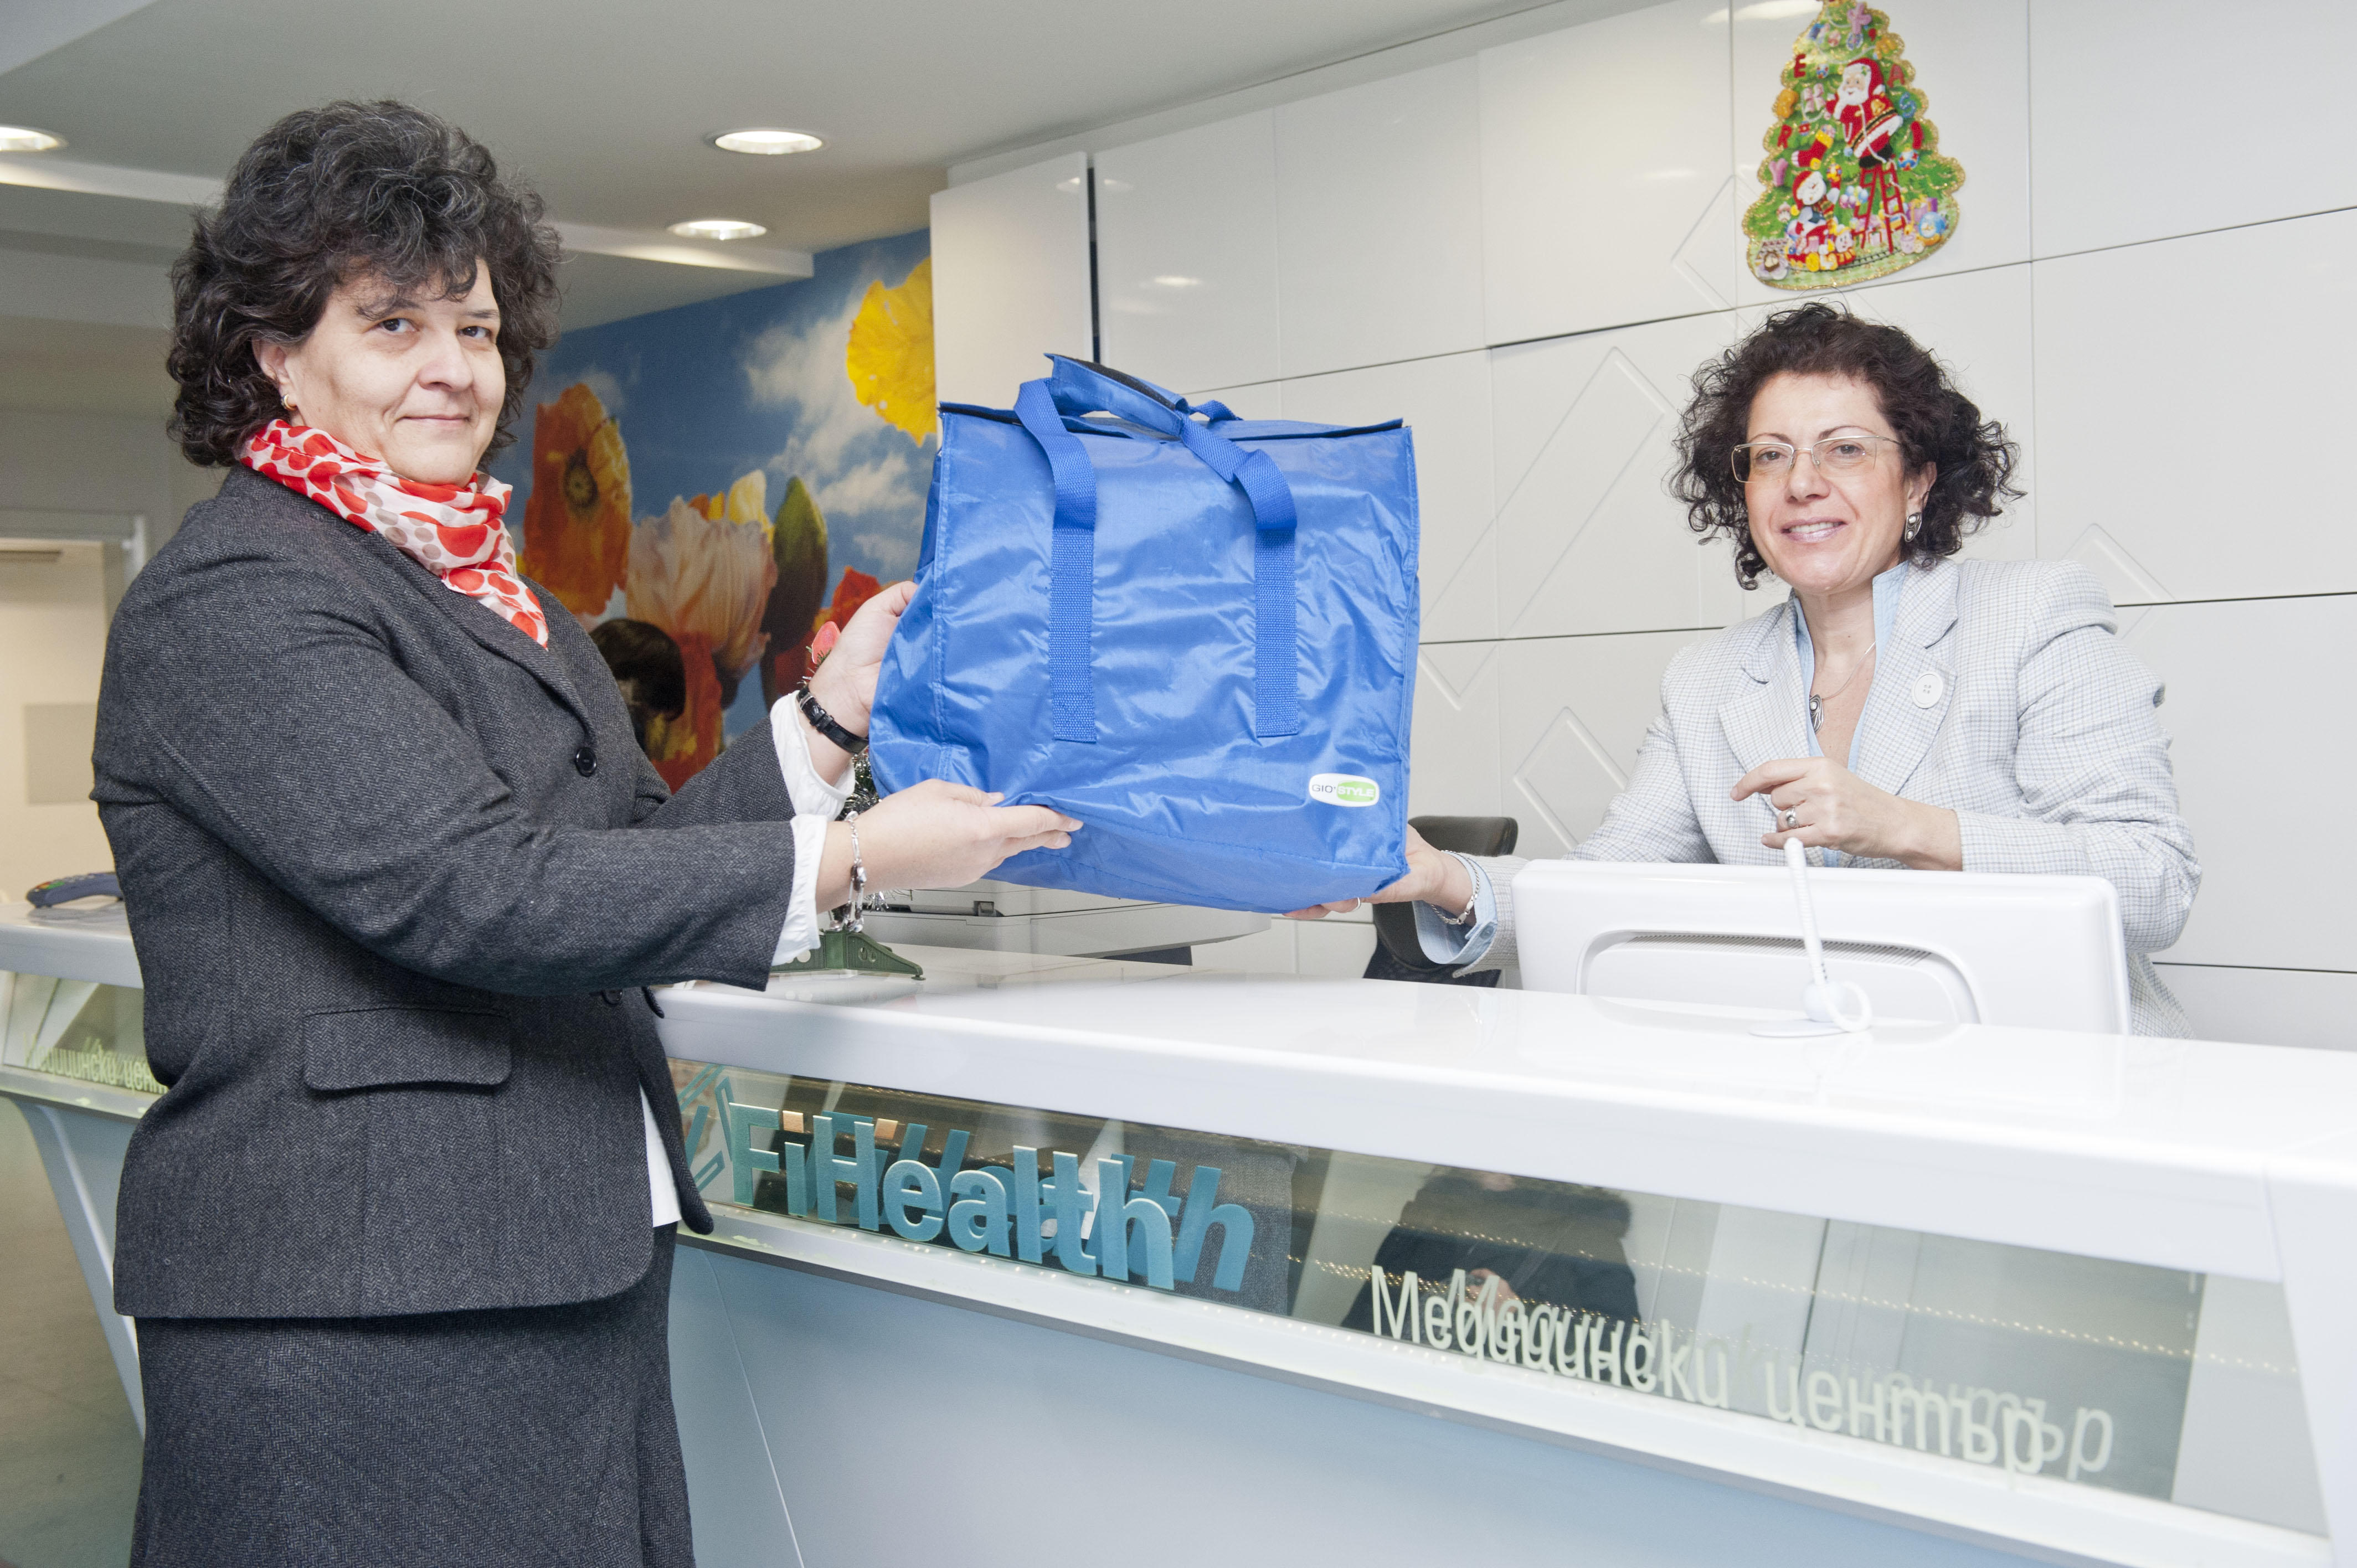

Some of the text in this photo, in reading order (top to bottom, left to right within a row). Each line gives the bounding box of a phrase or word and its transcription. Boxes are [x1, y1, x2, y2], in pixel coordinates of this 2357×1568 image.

[729, 1102, 1174, 1291] FiHealth
[1371, 1265, 2044, 1485] Медицински център
